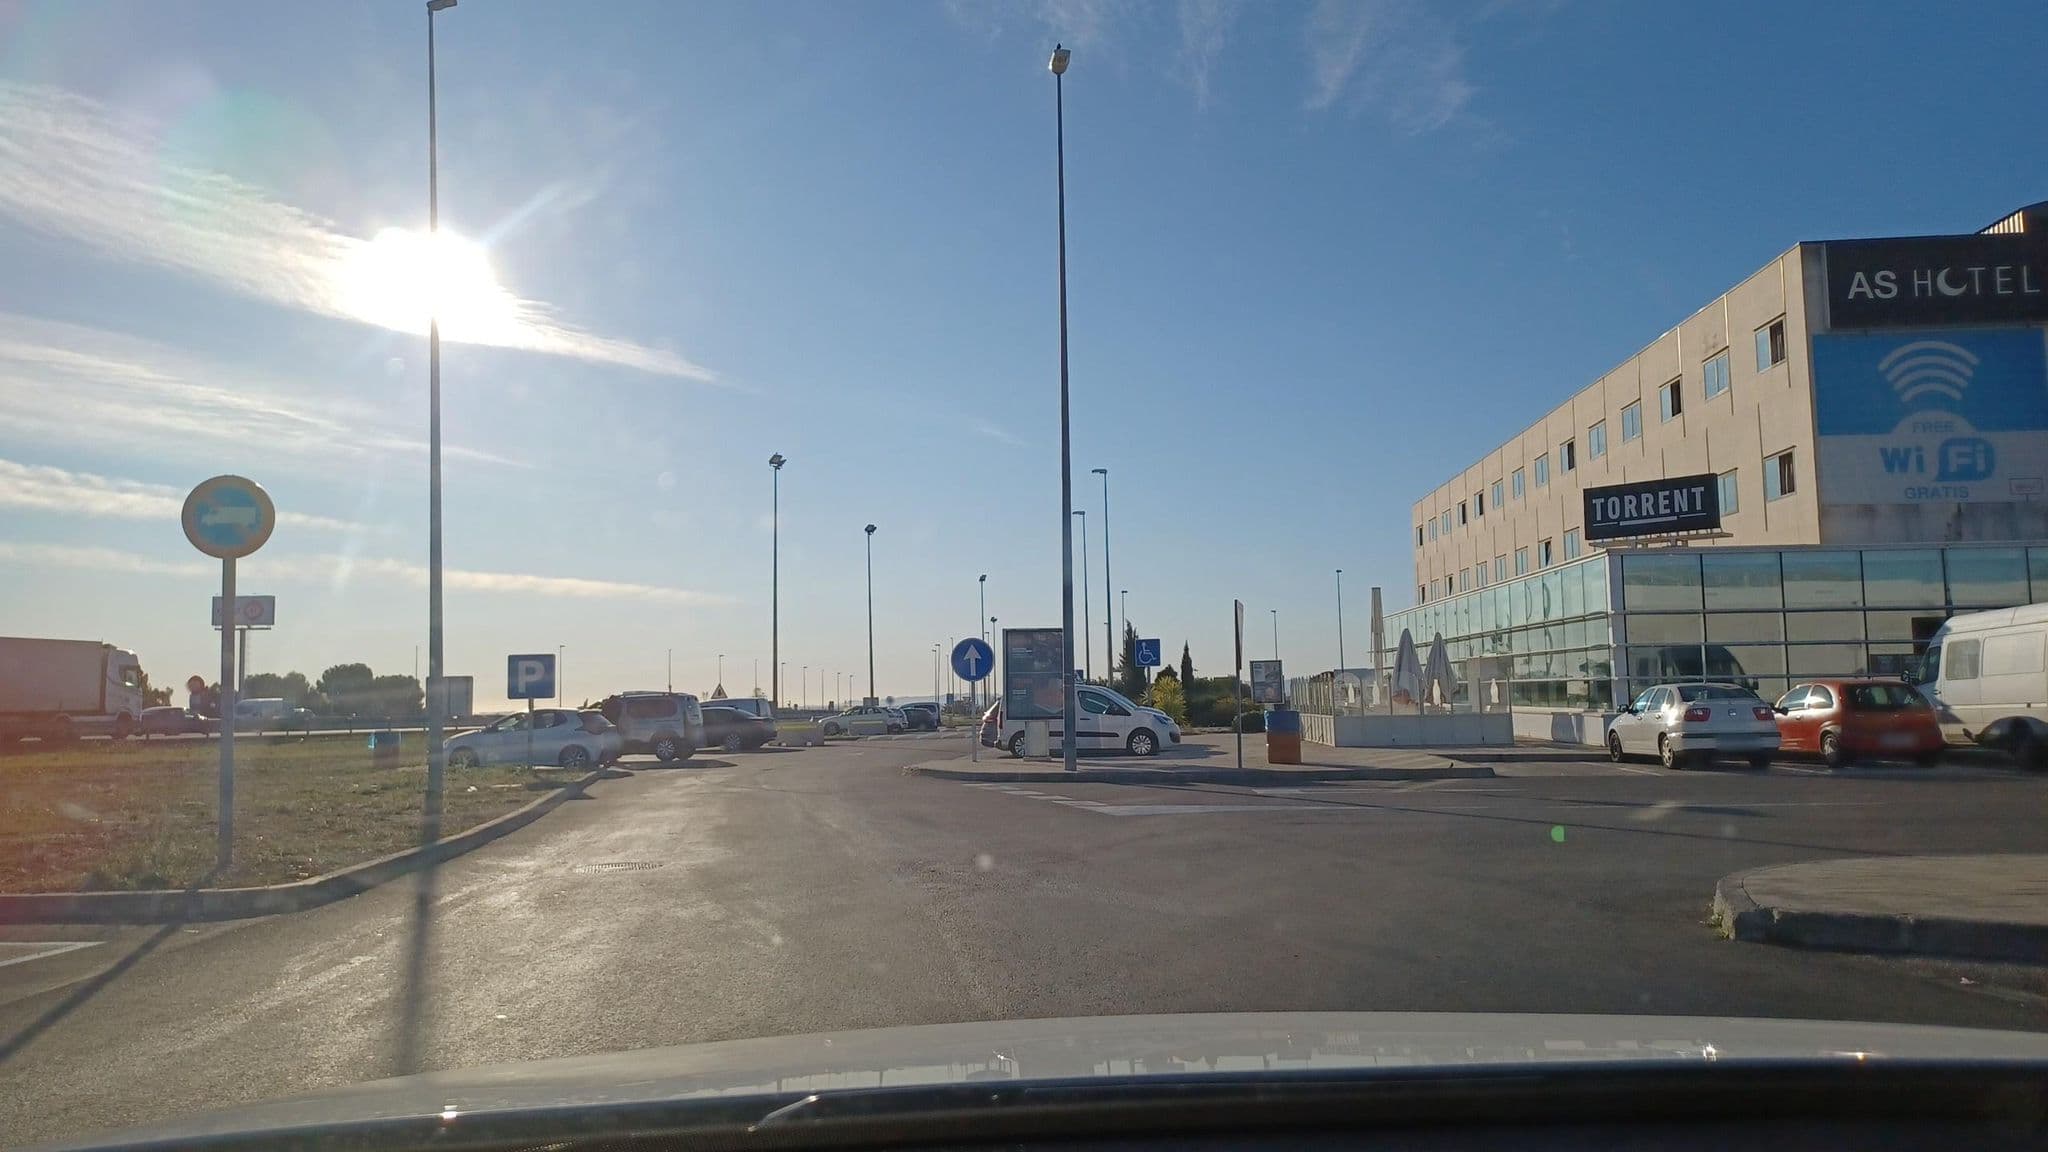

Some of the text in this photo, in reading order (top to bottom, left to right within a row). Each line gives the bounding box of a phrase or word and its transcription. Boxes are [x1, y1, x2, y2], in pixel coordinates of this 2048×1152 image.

[1848, 265, 2041, 299] AS HOTEL
[1912, 421, 1955, 433] FREE
[1592, 486, 1705, 520] TORRENT
[1904, 487, 1969, 499] GRATIS
[518, 660, 545, 693] P
